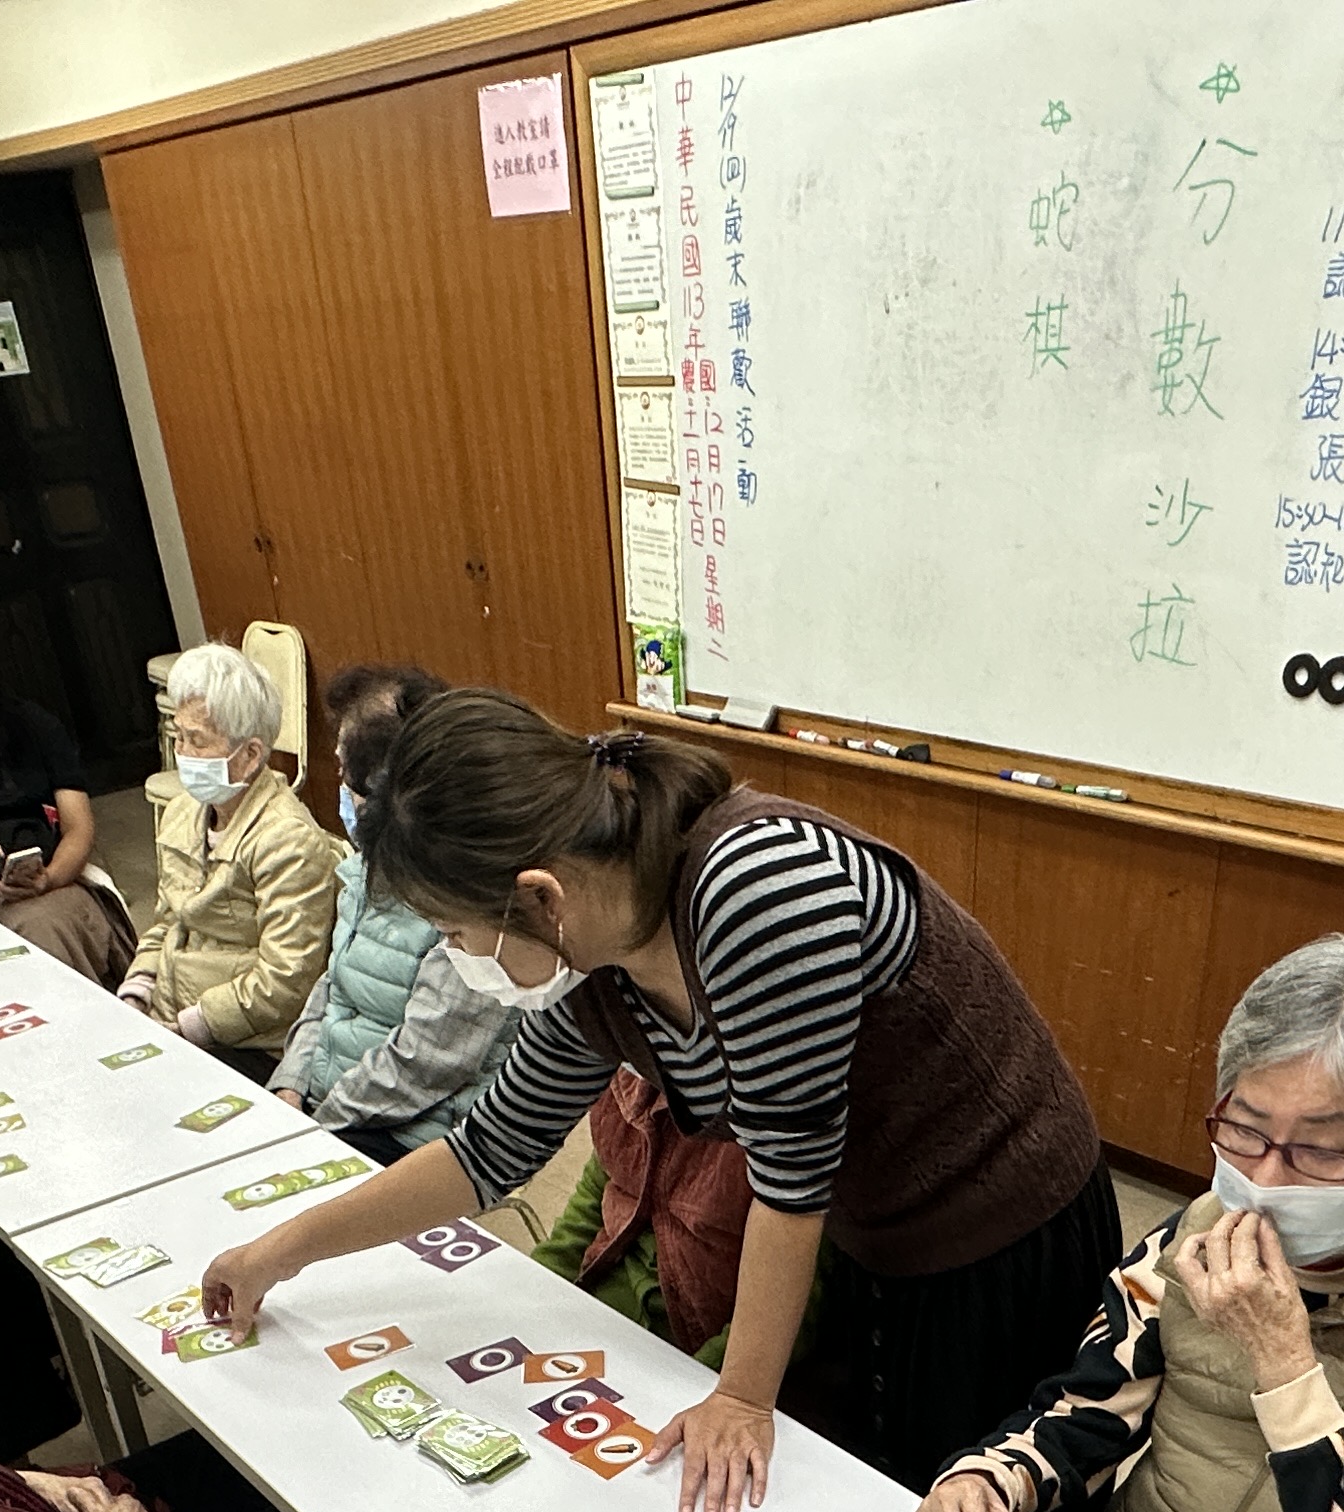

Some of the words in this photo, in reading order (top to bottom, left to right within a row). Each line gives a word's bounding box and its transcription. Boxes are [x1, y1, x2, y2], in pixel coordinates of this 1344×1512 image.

[1023, 170, 1079, 380] 蛇棋
[1129, 138, 1258, 668] 分數沙拉
